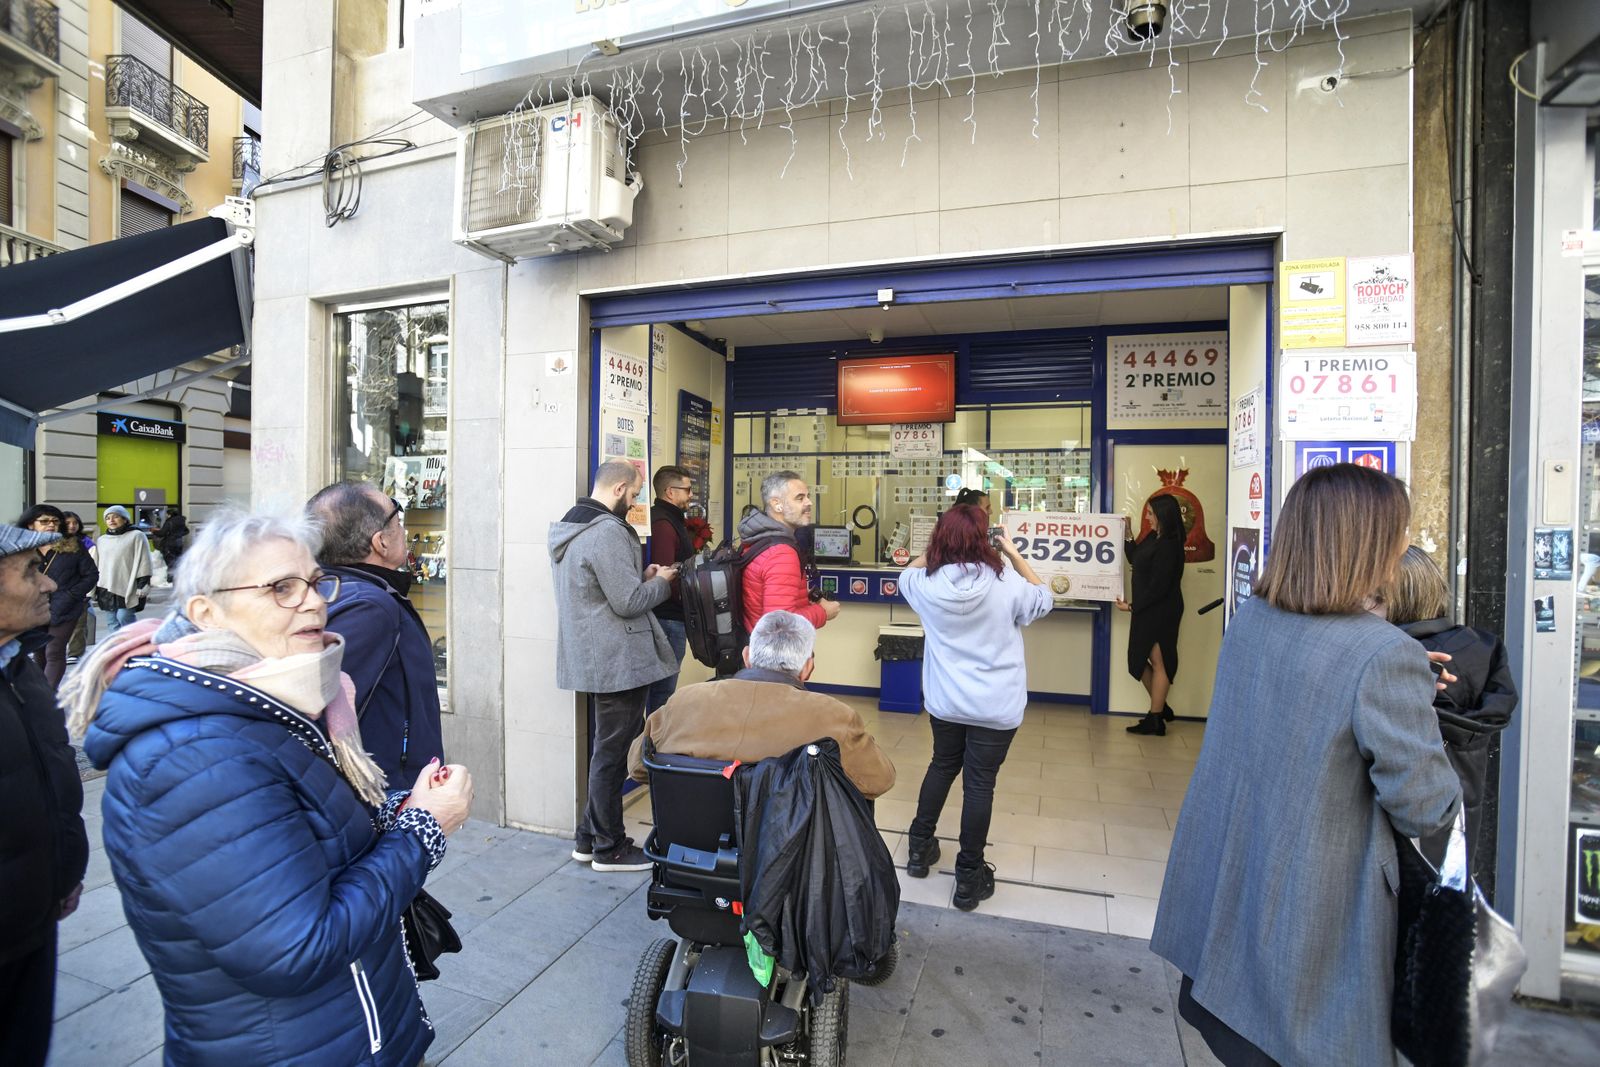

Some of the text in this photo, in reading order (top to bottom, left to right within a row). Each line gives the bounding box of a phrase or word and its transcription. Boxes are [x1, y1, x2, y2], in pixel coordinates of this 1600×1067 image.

[1300, 262, 1340, 270] VIDEOVIGILADA
[1357, 282, 1404, 297] RODYCH
[1357, 295, 1405, 305] SEGURIDAD
[1393, 321, 1408, 329] 114
[1123, 348, 1219, 368] 44469
[1319, 359, 1389, 372] PREMIO
[608, 356, 644, 378] 44469
[616, 374, 643, 391] PREMIO
[1142, 371, 1216, 387] PREMIO
[1289, 374, 1397, 394] 07861
[130, 420, 174, 436] CaixaBank
[616, 417, 635, 432] BOTES
[894, 430, 935, 440] 07861
[1035, 522, 1109, 538] PREMIO
[1011, 536, 1116, 564] 25296
